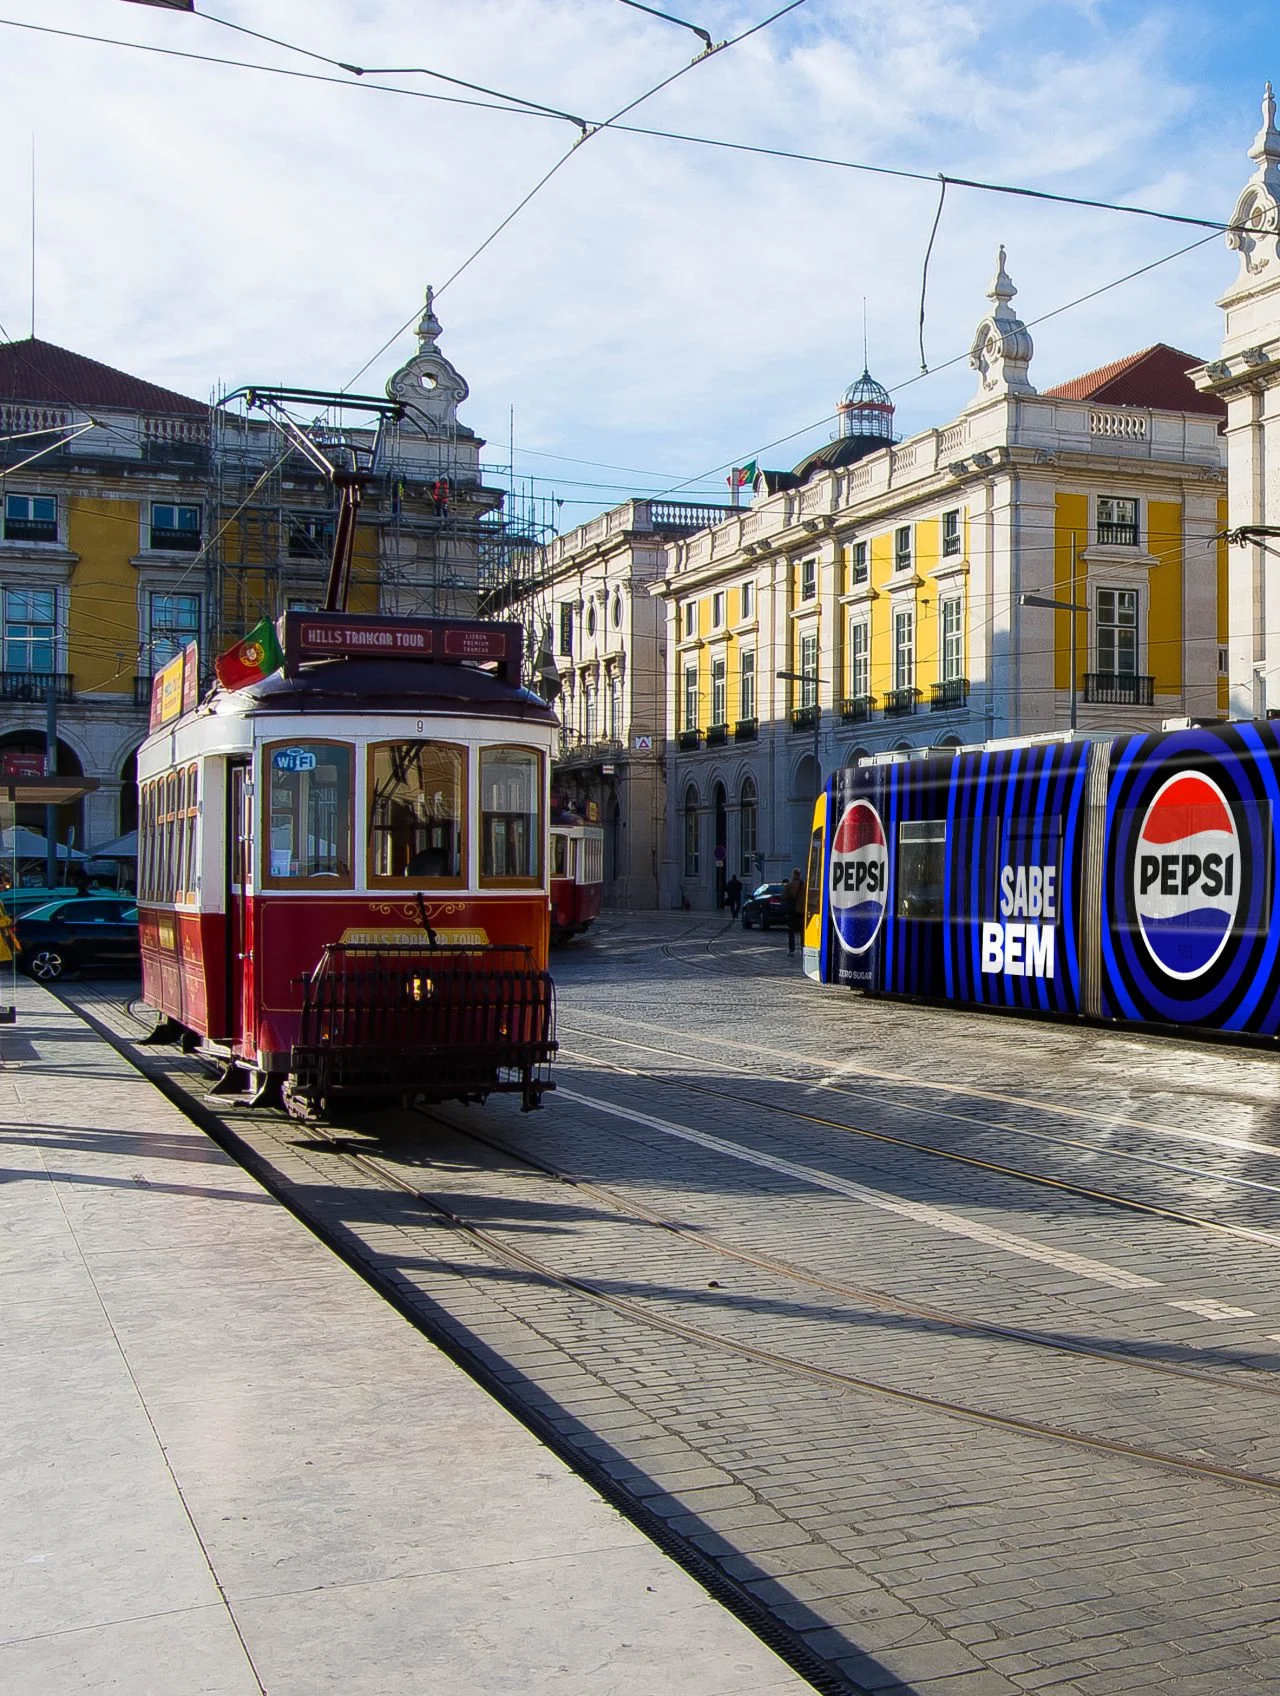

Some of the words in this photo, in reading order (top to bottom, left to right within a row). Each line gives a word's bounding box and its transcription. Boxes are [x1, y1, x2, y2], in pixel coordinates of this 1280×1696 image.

[308, 629, 342, 644] HILLS
[345, 631, 393, 646] TRAMCAR
[396, 633, 425, 647] TOUR
[416, 720, 424, 733] 9
[832, 861, 885, 892] PEPSI
[1140, 853, 1234, 897] PEPSI
[1000, 865, 1056, 918] SABE
[982, 922, 1055, 979] BEM
[838, 968, 853, 979] ZERO
[853, 970, 873, 980] SUGAR
